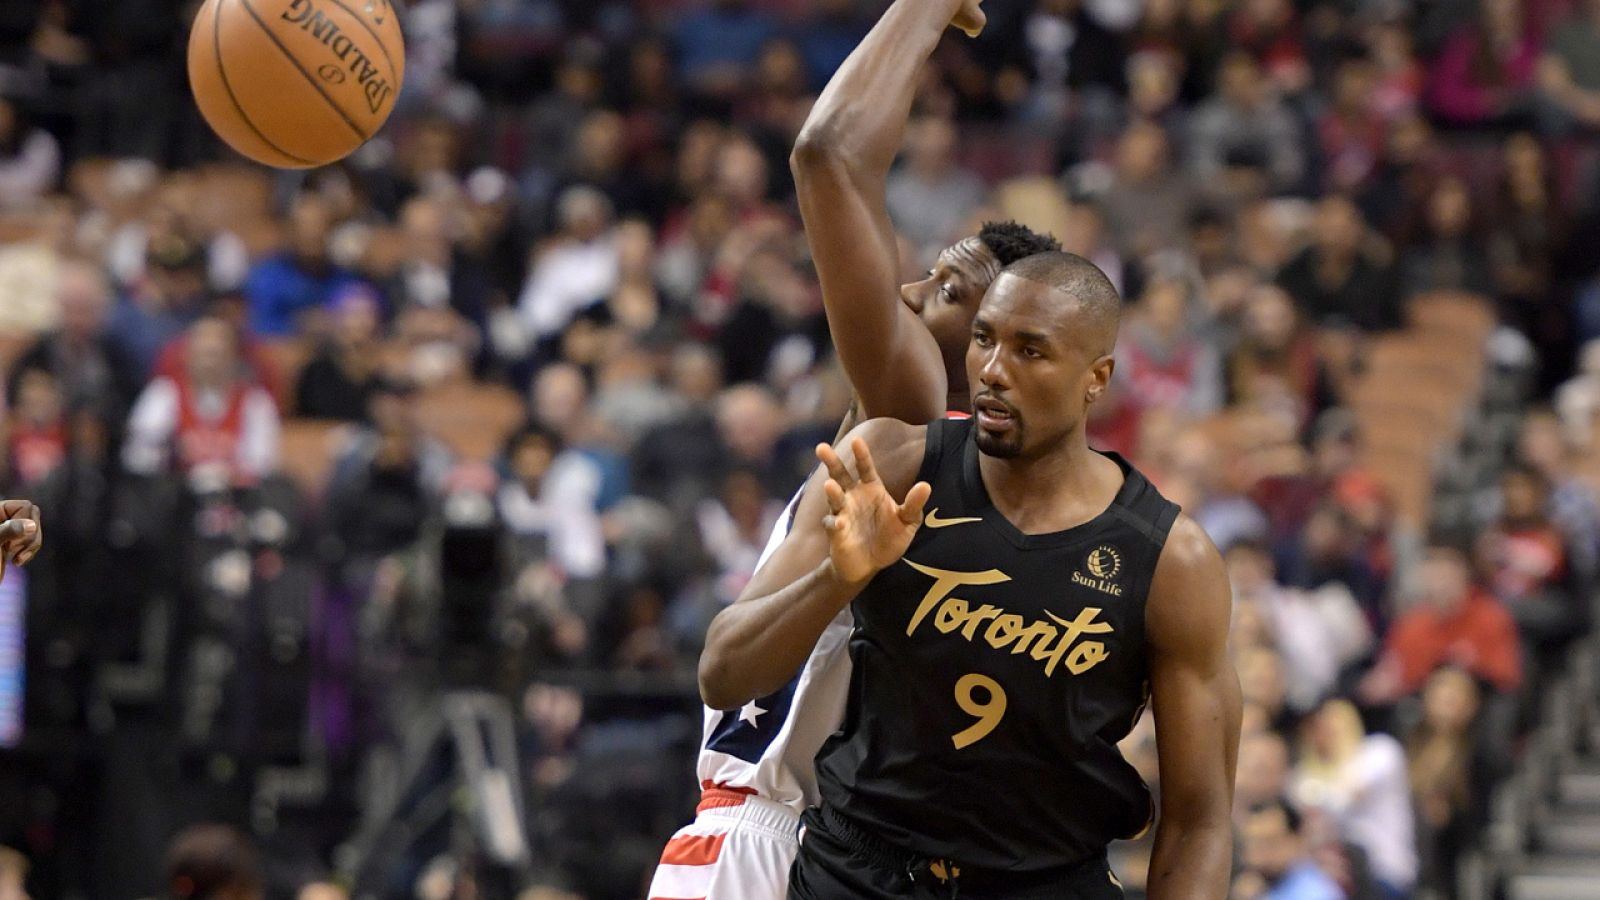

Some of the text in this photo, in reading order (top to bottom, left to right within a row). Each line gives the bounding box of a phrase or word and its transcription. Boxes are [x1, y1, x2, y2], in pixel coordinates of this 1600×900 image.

[281, 0, 392, 114] SPALDING
[901, 557, 1114, 678] Toronto
[1071, 570, 1122, 597] Sun Life
[951, 673, 1007, 750] 9
